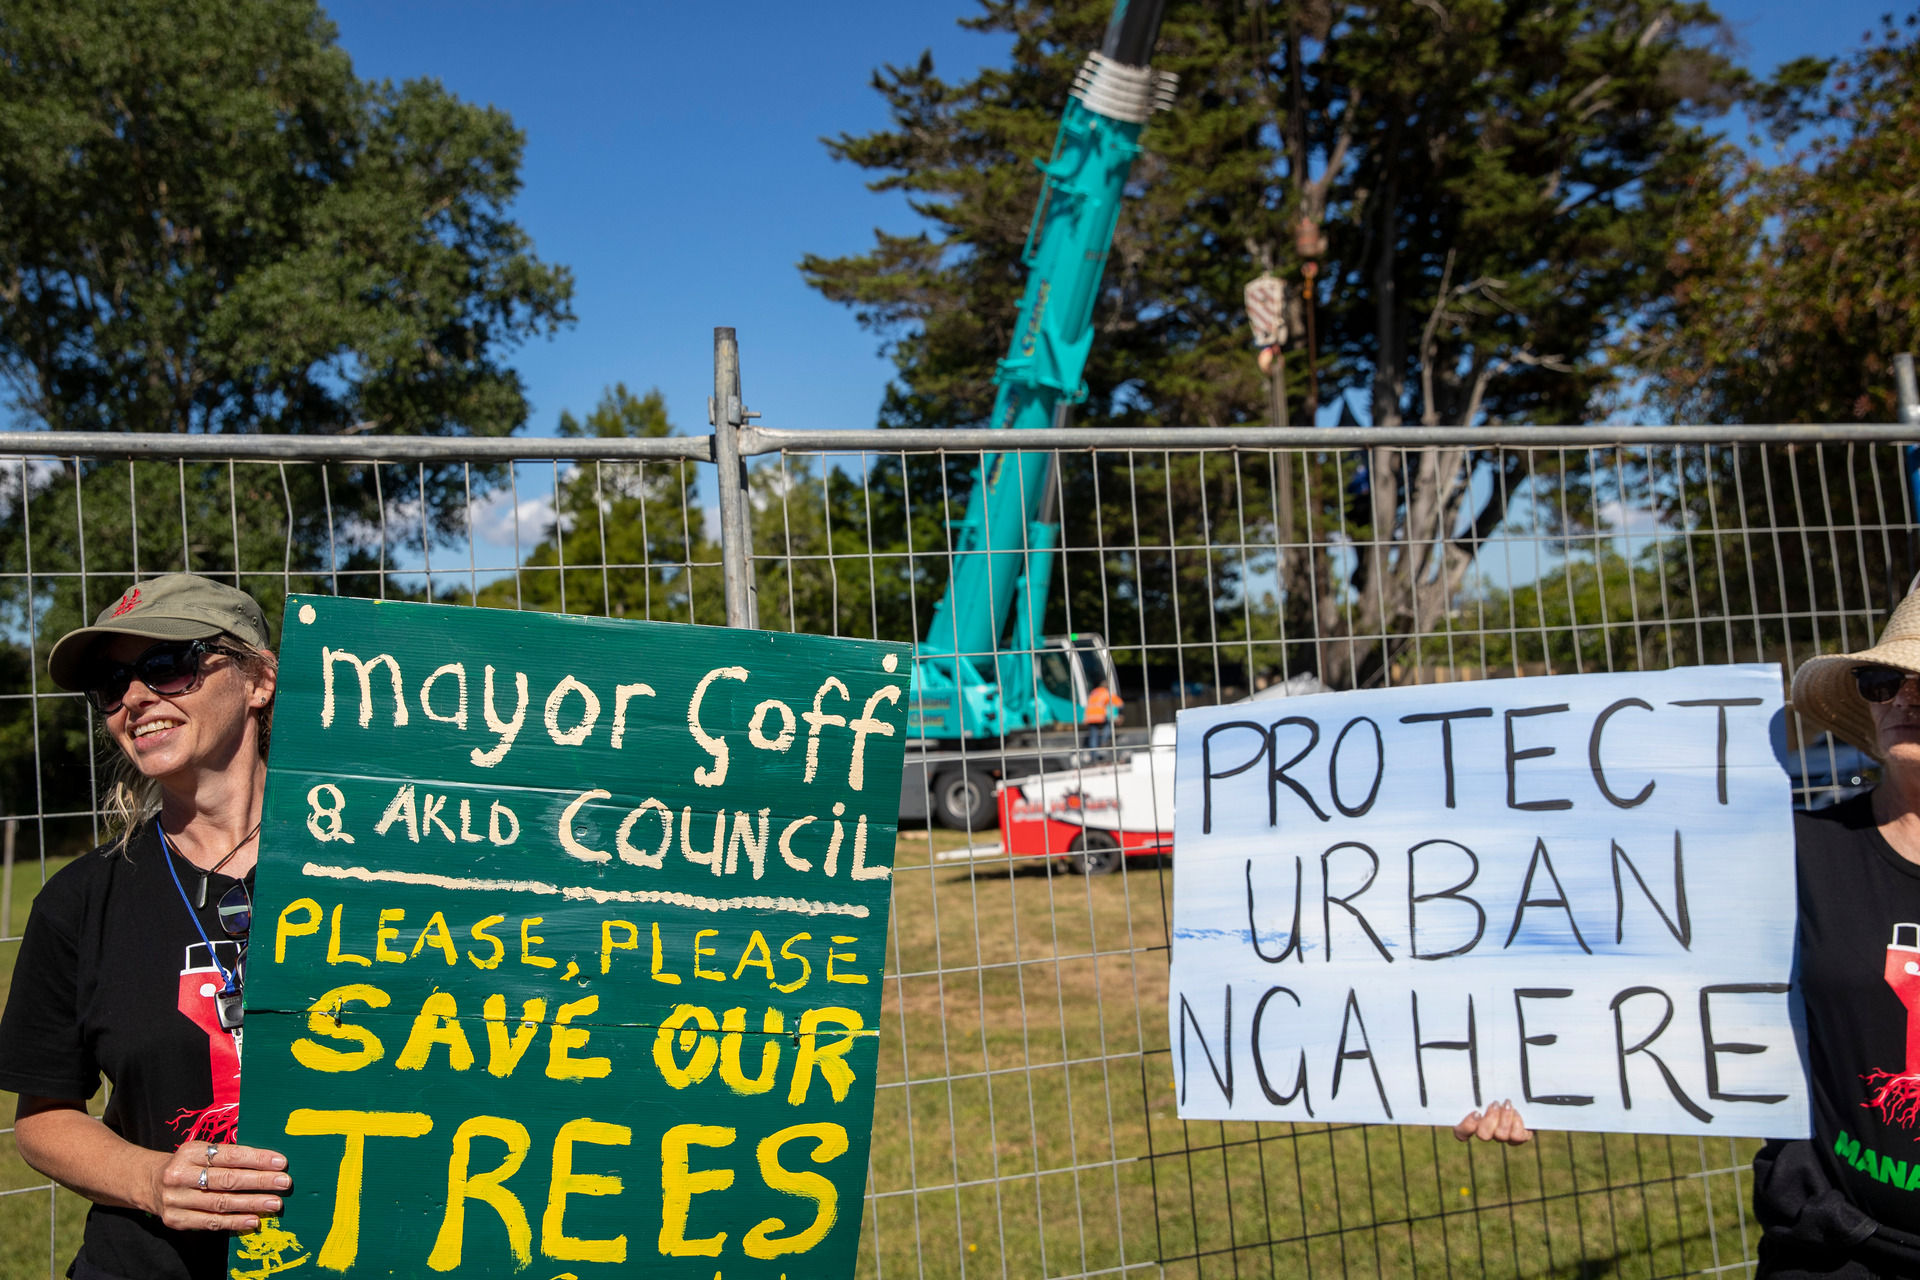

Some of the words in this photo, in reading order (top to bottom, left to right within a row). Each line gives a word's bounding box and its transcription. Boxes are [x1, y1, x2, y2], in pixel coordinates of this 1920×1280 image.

[307, 784, 355, 844] &
[374, 783, 521, 846] AKLD
[1203, 697, 1763, 834] PROTECT
[275, 898, 580, 981] PLEASE,
[601, 920, 869, 993] PLEASE
[1247, 830, 1691, 963] URBAN
[291, 984, 612, 1080] SAVE
[652, 1003, 865, 1106] OUR
[1180, 983, 1791, 1123] NGAHERE
[284, 1109, 849, 1273] TREES
